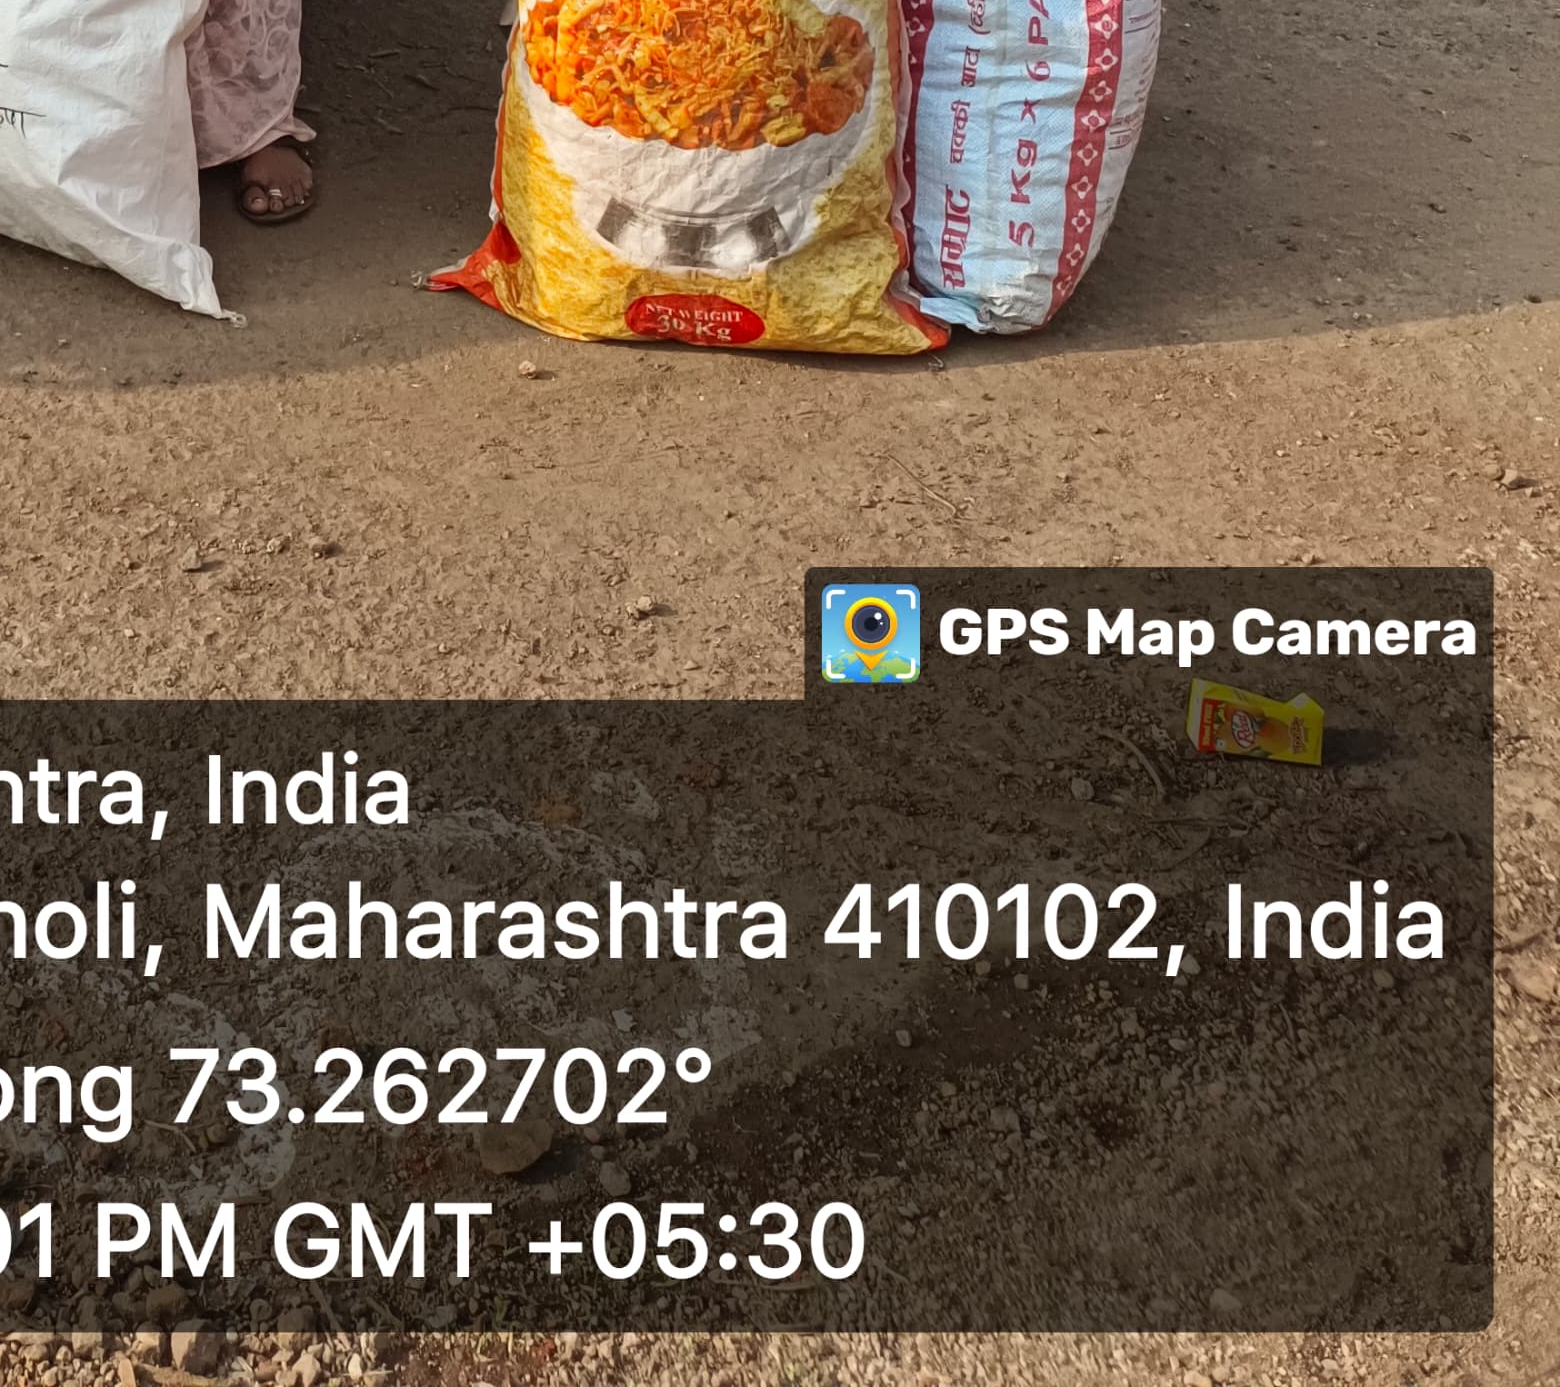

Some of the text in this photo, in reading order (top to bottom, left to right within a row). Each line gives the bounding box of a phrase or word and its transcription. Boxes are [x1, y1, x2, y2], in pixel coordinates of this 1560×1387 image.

[1025, 61, 1051, 82] 6
[949, 99, 971, 164] चक्की
[1009, 138, 1038, 204] Kg
[1008, 220, 1034, 248] 5
